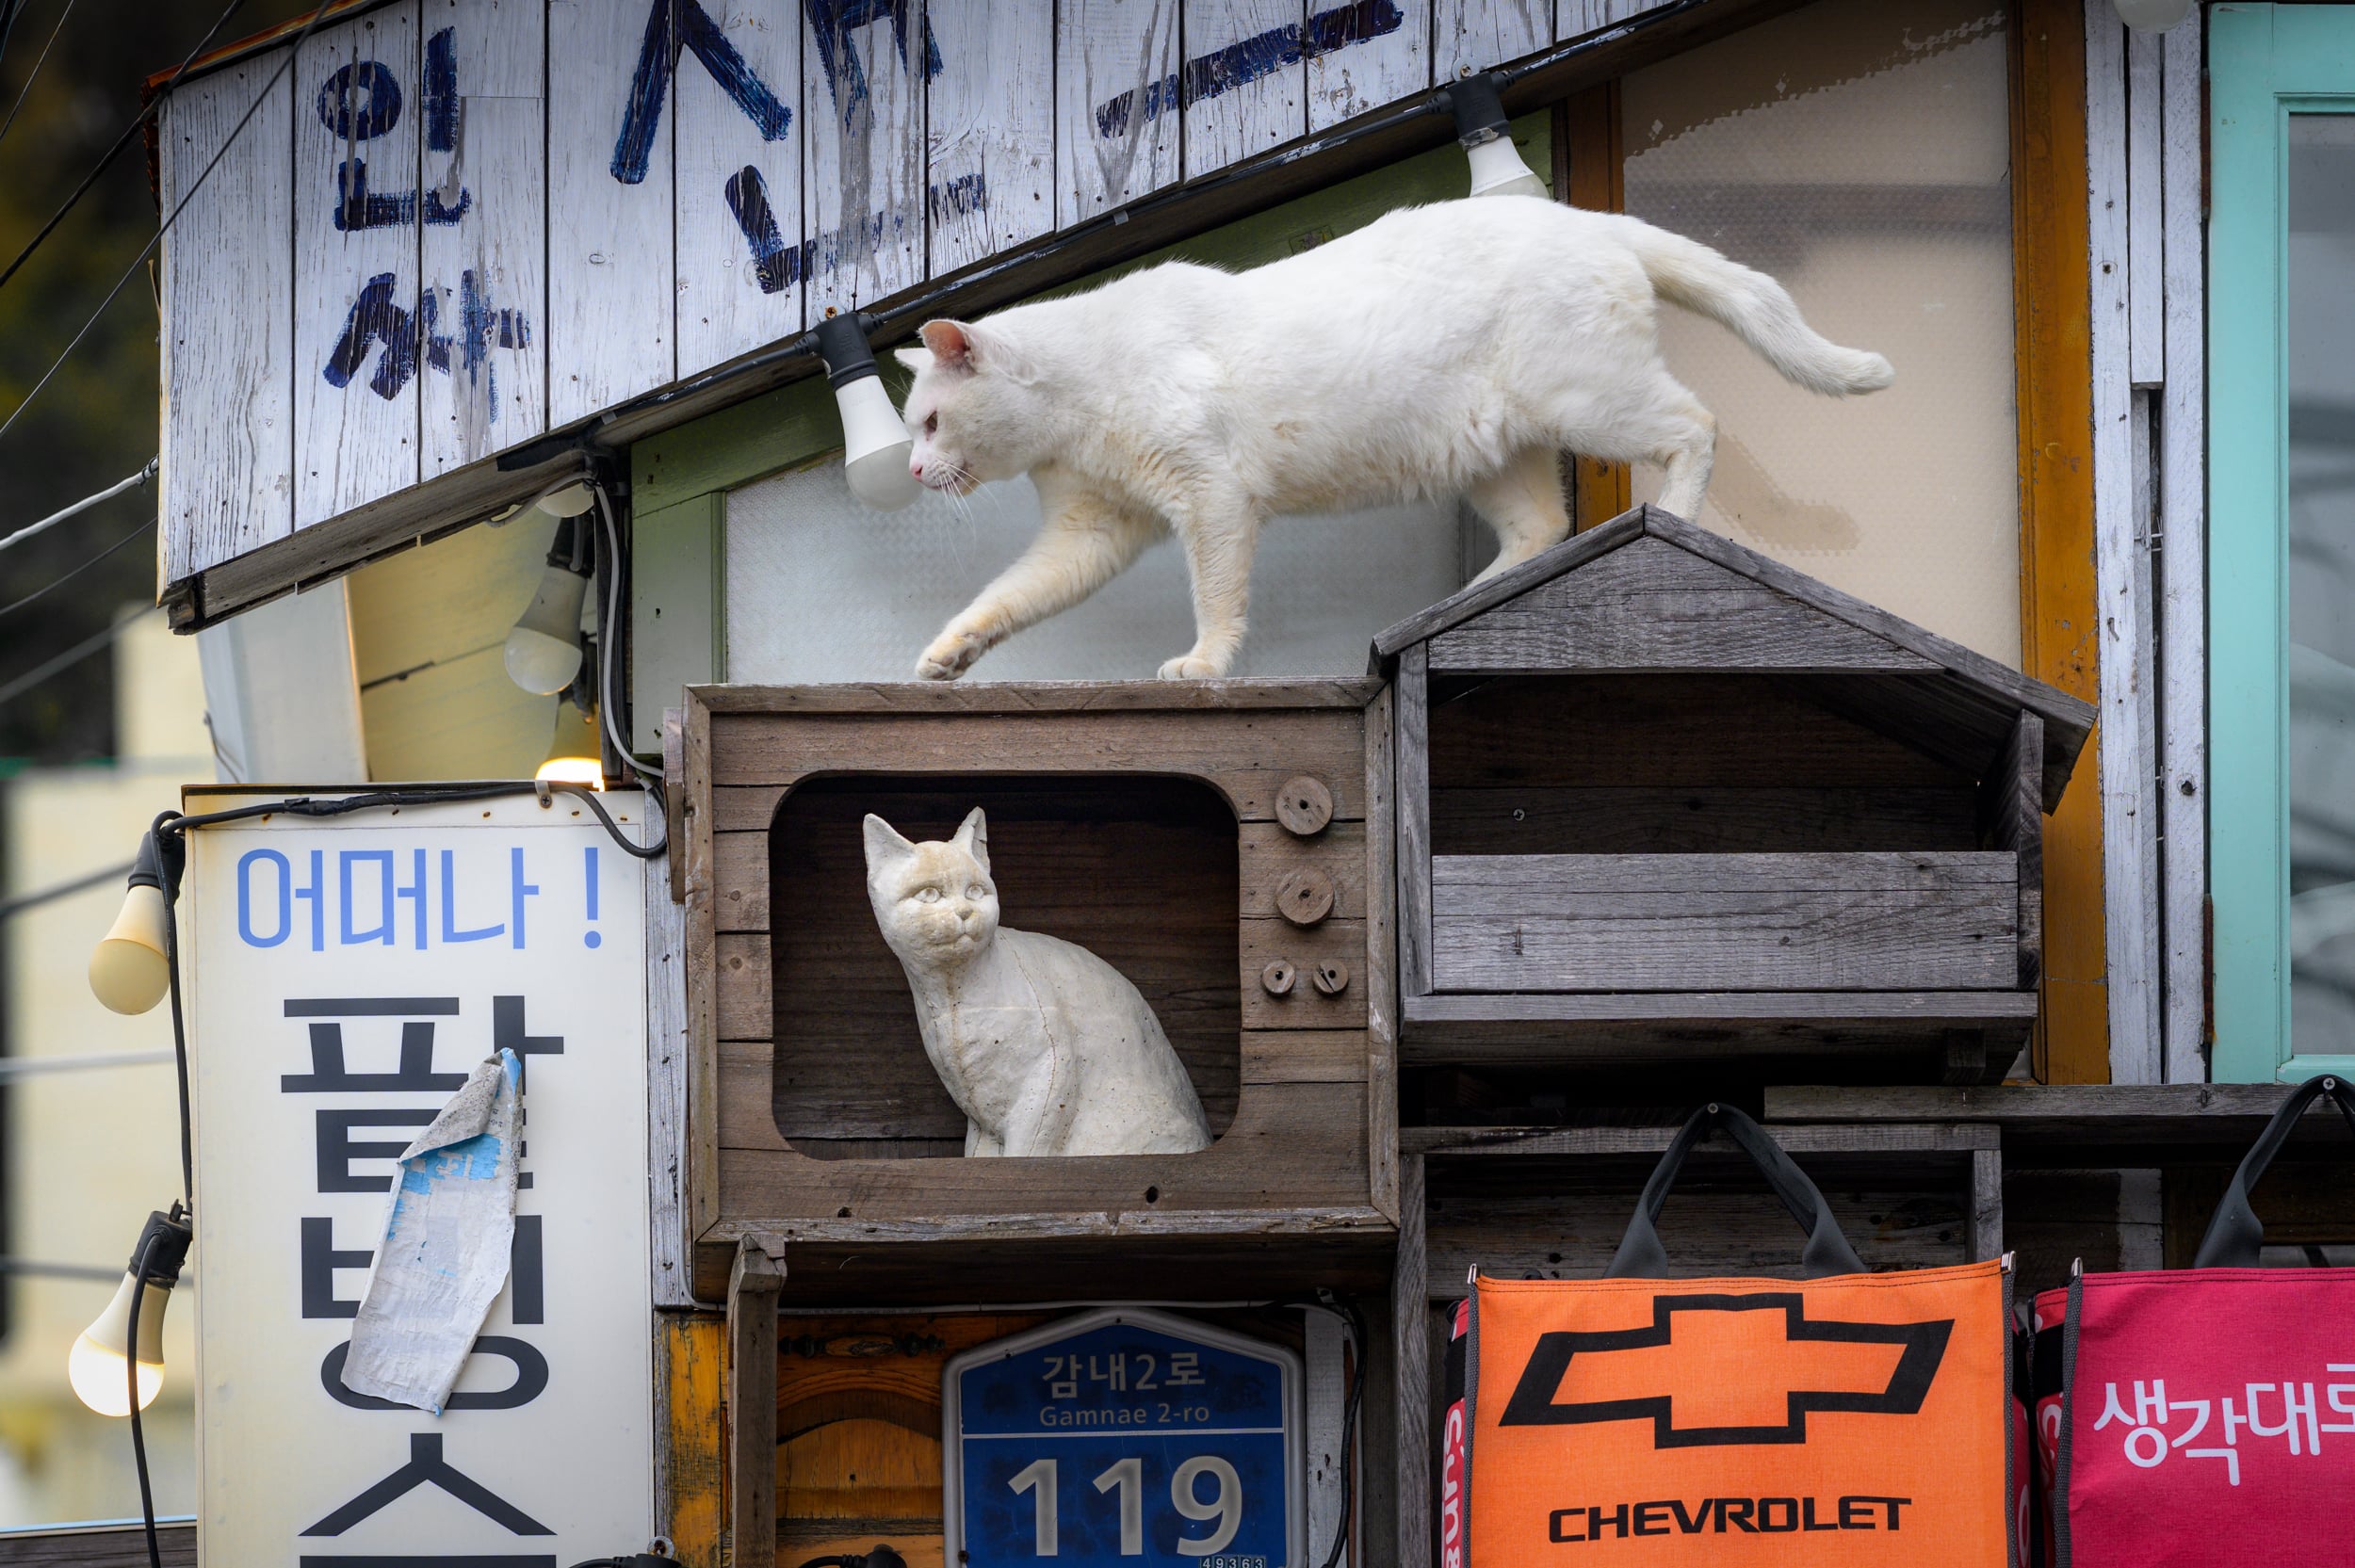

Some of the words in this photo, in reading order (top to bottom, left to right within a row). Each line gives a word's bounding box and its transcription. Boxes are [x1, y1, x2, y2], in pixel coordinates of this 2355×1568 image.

[1041, 1351, 1207, 1400] 감내2로
[1038, 1405, 1147, 1428] Gamnae
[1157, 1401, 1210, 1424] 2-ro
[1007, 1454, 1242, 1557] 119
[1548, 1495, 1913, 1544] CHEVROLET
